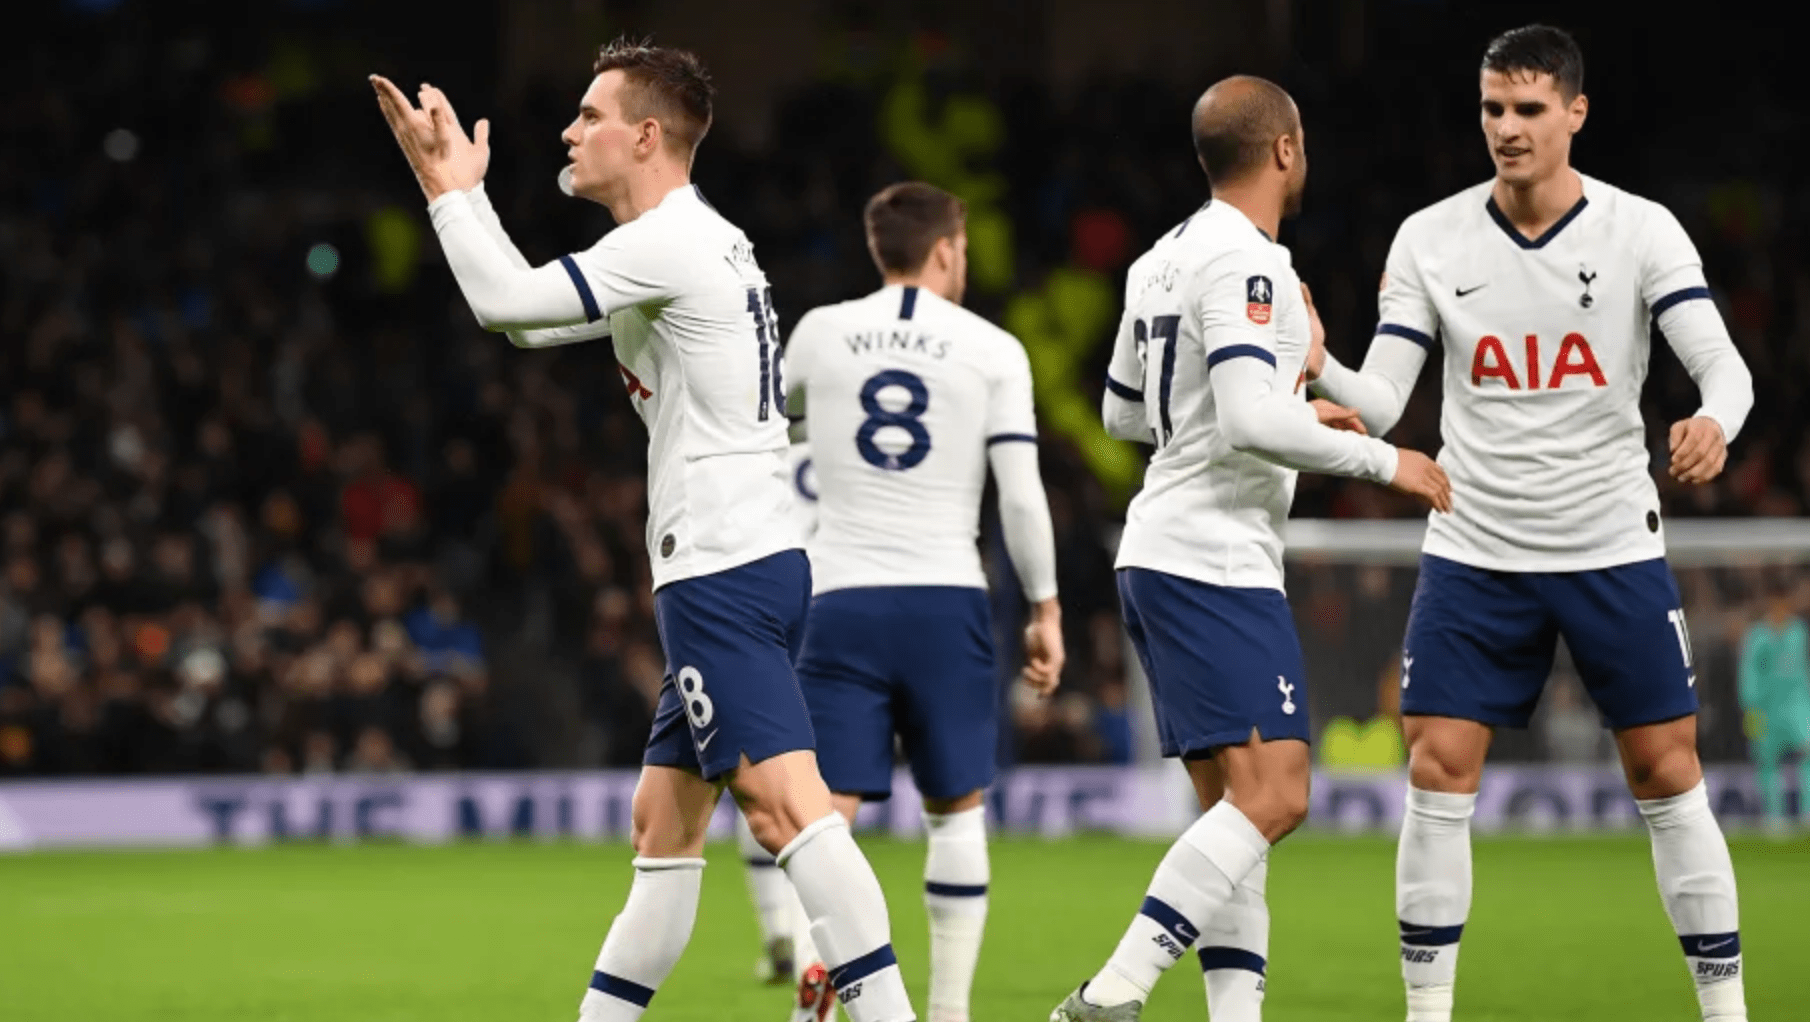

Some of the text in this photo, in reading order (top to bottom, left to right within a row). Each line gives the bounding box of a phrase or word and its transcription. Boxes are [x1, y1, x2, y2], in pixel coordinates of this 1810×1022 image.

[844, 331, 951, 359] WINKS
[1471, 332, 1608, 390] AIA
[855, 369, 931, 471] 8
[1696, 960, 1740, 977] SPURS
